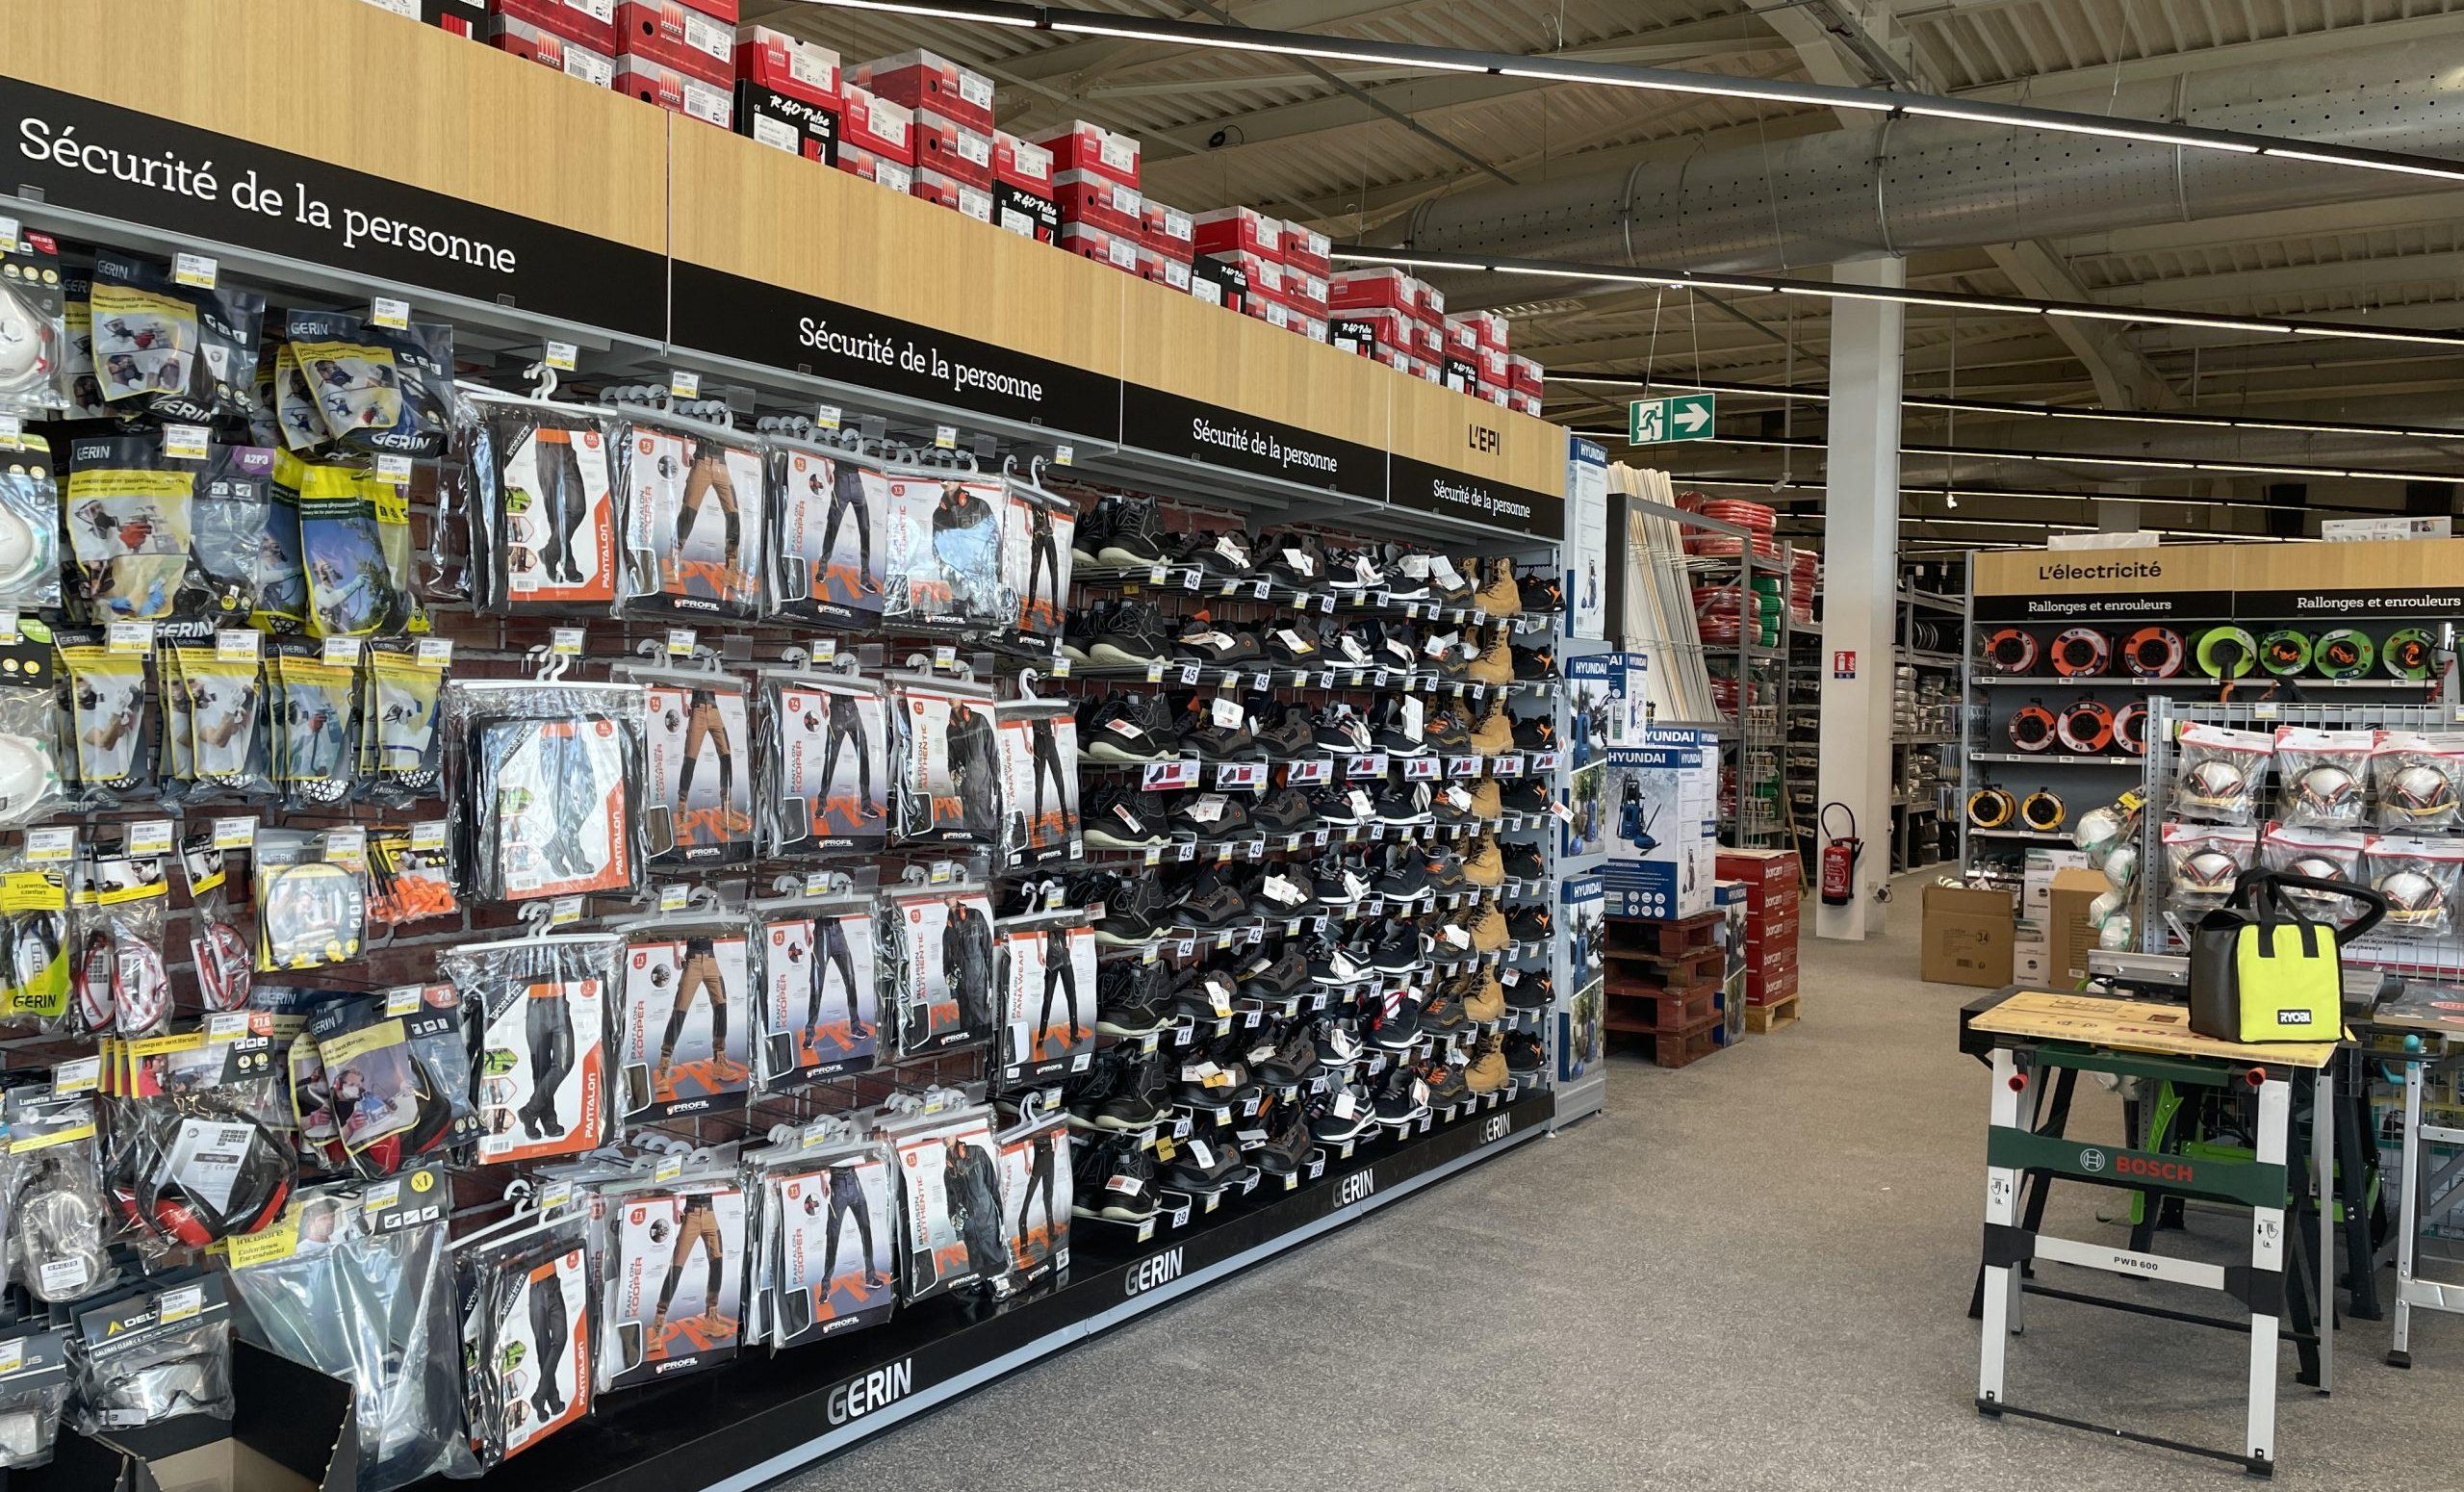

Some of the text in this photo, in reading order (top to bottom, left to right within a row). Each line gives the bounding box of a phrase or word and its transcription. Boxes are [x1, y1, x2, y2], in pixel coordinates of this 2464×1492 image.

[18, 116, 517, 275] Sécurité de la personne
[97, 259, 129, 281] GERIN
[290, 322, 329, 336] GERIN
[798, 317, 1043, 403] Sécurité de la personne
[149, 399, 213, 424] GERIN
[370, 432, 431, 451] GERIN
[1192, 418, 1338, 475] Sécurité de la personne
[1468, 423, 1502, 457] L'EPI
[77, 445, 111, 461] GERIN
[244, 453, 270, 466] A2P3
[1580, 443, 1605, 464] HYUNDAI
[1433, 479, 1531, 520] Sécurité de la personne
[796, 500, 806, 553] KOOPER
[602, 523, 610, 589] PANTALON
[2039, 561, 2163, 580] L'électricité
[1186, 574, 1199, 588] 46
[1256, 585, 1268, 596] 46
[681, 599, 720, 611] PROFIL
[1323, 600, 1333, 610] 46
[1378, 594, 1388, 605] 46
[2297, 595, 2462, 612] Rallonges et enrouleurs
[823, 605, 852, 618] PROFIL
[1430, 608, 1439, 619] 46
[2028, 599, 2172, 615] Rallonges et enrouleurs
[932, 614, 965, 624] PROFIL
[1476, 613, 1483, 624] 46
[1517, 622, 1525, 631] 46
[59, 634, 91, 646] GERIN
[1024, 636, 1046, 648] PROFIL
[282, 643, 309, 655] GERIN
[1576, 661, 1606, 675] HYUNDAI
[1629, 656, 1647, 667] HYUNDAI
[1184, 669, 1197, 682] 45
[1256, 677, 1268, 687] 45
[1322, 675, 1333, 685] 45
[1376, 674, 1386, 684] 45
[1427, 679, 1436, 689] 45
[1475, 687, 1483, 698] 45
[1645, 732, 1695, 744] YUNDAI
[1701, 732, 1718, 743] HYUNDAI
[1607, 752, 1666, 764] HYUNDAI
[1681, 752, 1702, 764] HYUNDAI
[946, 832, 973, 840] PROFIL
[1317, 832, 1326, 843] 43
[1373, 826, 1382, 837] 43
[1425, 827, 1434, 837] 43
[1472, 826, 1479, 836] 43
[616, 810, 625, 876] PANTALON
[823, 838, 854, 848] PROFIL
[690, 846, 721, 858] PROFIL
[1040, 850, 1063, 861] PROFIL
[1181, 846, 1193, 858] 43
[1251, 844, 1262, 856] 43
[1765, 865, 1784, 879] borcam
[1574, 882, 1603, 899] HYUNDAI
[1471, 893, 1478, 903] 42
[1765, 894, 1783, 908] borcam
[1372, 903, 1381, 913] 42
[1425, 901, 1433, 912] 42
[1316, 919, 1325, 930] 42
[1766, 923, 1784, 937] borcam
[1250, 931, 1262, 942] 42
[1180, 942, 1192, 955] 42
[1764, 952, 1782, 966] borcam
[1015, 949, 1025, 1020] PANAWEAR
[1424, 973, 1432, 984] 41
[1372, 984, 1380, 995] 41
[1765, 980, 1783, 993] borcam
[13, 993, 57, 1009] GERIN
[257, 991, 296, 1005] GERIN
[1315, 996, 1324, 1008] 41
[253, 1016, 270, 1029] 27.6
[1248, 1015, 1259, 1026] 41
[2279, 1011, 2311, 1024] RYOBI
[311, 1016, 337, 1037] GERIN
[637, 1000, 646, 1060] KOOPER
[945, 1031, 970, 1044] PROFIL
[1178, 1031, 1190, 1043] 41
[1423, 1045, 1431, 1057] 40
[811, 1063, 843, 1076] PROFIL
[1040, 1062, 1064, 1075] PROFIL
[1371, 1062, 1379, 1073] 40
[1314, 1080, 1324, 1092] 40
[19, 1095, 50, 1107] Lunette
[585, 1072, 597, 1140] PANTALON
[674, 1099, 710, 1115] PROFIL
[1247, 1102, 1258, 1115] 40
[1177, 1121, 1189, 1135] 40
[1479, 1112, 1512, 1145] GERIN
[1313, 1165, 1323, 1176] 39
[2115, 1155, 2194, 1183] BOSCH
[1246, 1178, 1258, 1192] 39
[1332, 1169, 1374, 1207] GERIN
[921, 1174, 930, 1247] AUTHENTIC
[1175, 1210, 1187, 1223] 39
[796, 1227, 805, 1285] KOOPER
[2113, 1255, 2159, 1272] PWB 600
[1124, 1246, 1185, 1297] GERIN
[631, 1255, 644, 1318] KOOPER
[954, 1273, 981, 1288] PROFIL
[625, 1262, 636, 1319] PANTALON
[828, 1315, 860, 1331] PROFIL
[662, 1356, 699, 1371] PROFIL
[827, 1358, 912, 1426] GERIN
